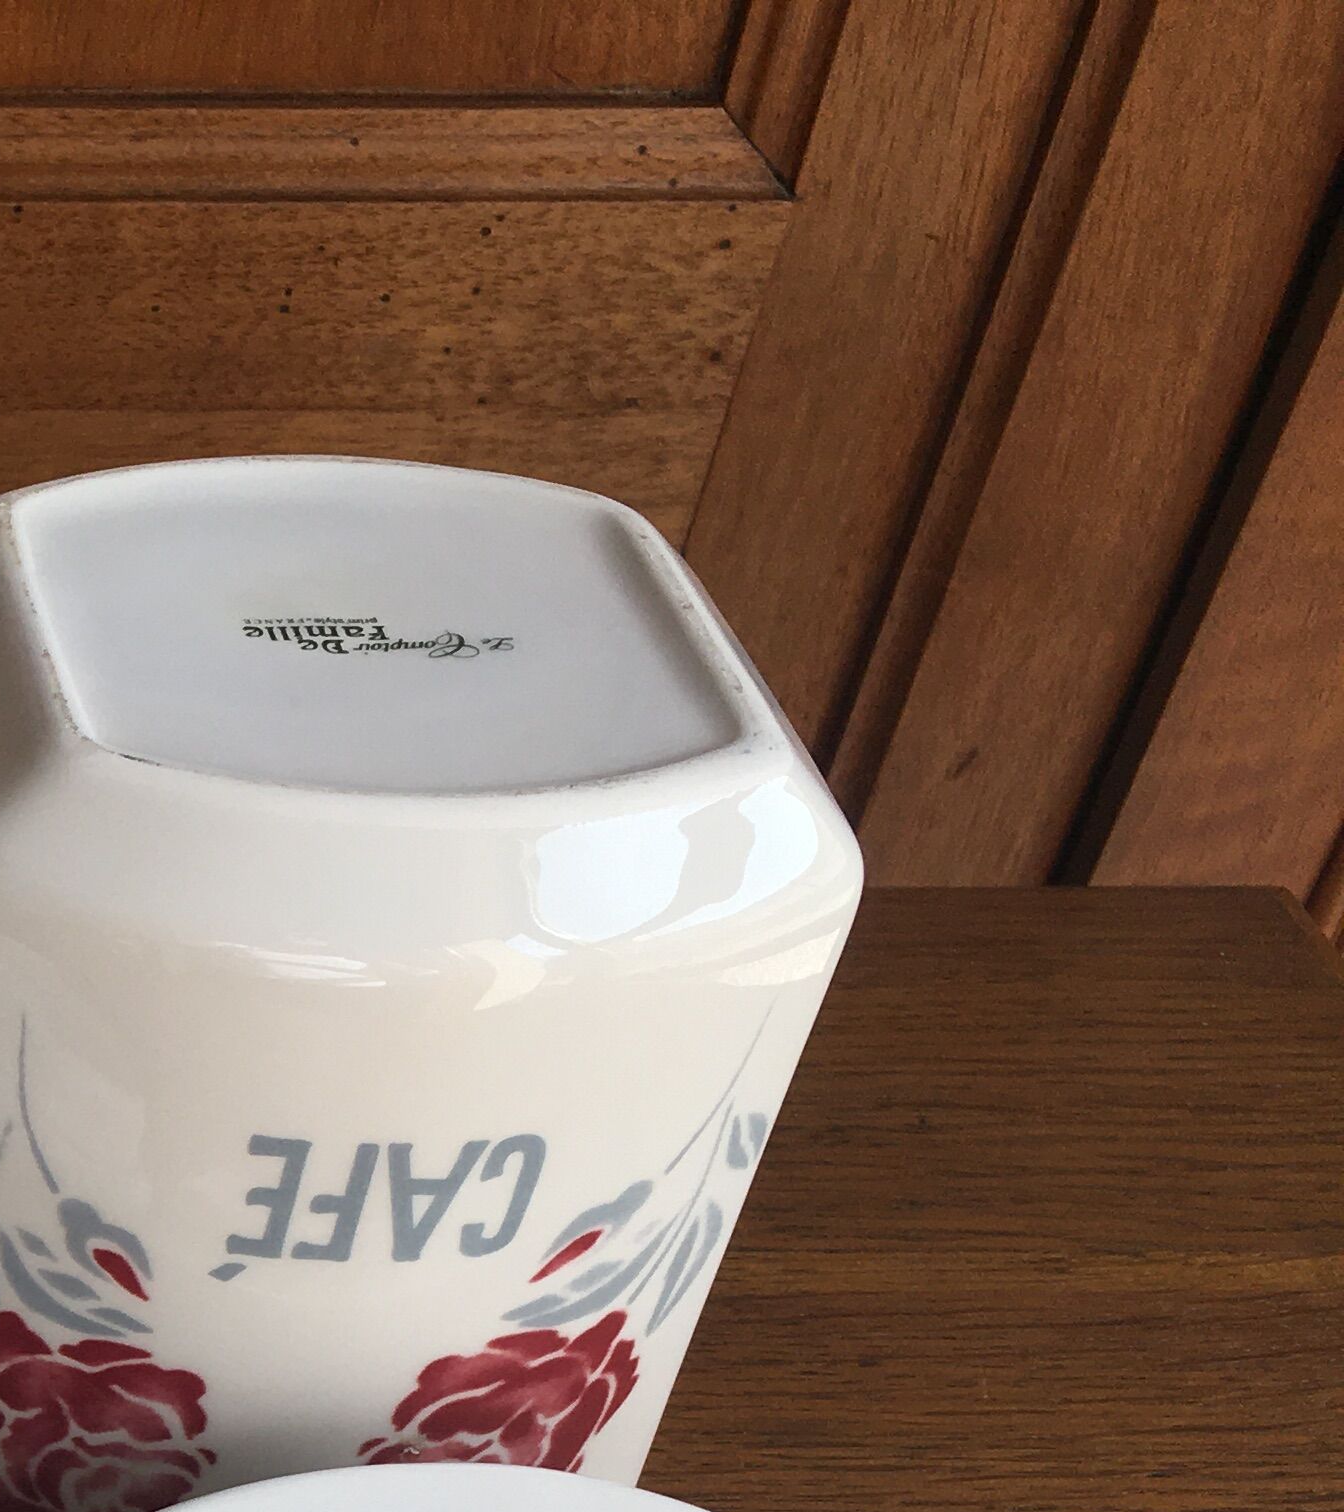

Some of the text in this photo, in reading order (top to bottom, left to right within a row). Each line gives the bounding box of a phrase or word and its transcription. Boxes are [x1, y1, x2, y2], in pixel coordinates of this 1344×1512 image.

[242, 625, 390, 642] Famille
[297, 630, 514, 658] Le Comptoir De
[207, 1133, 547, 1282] CAFÉ
